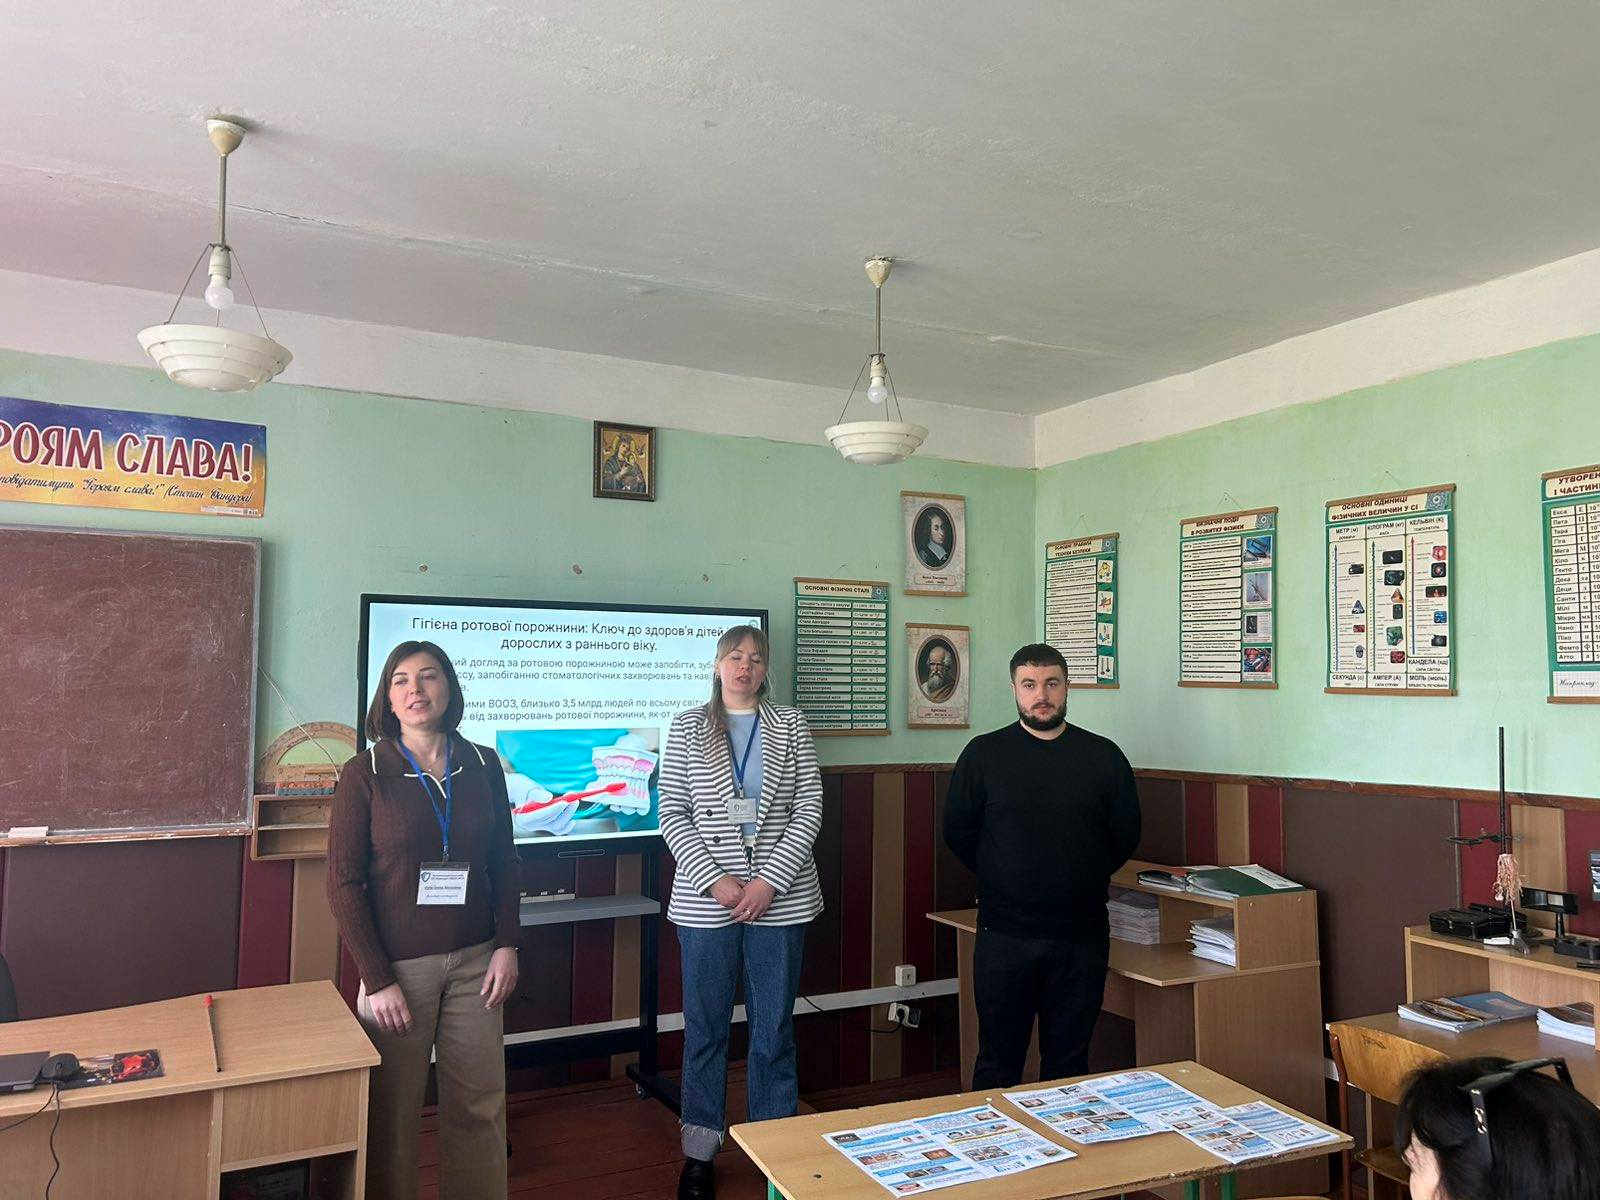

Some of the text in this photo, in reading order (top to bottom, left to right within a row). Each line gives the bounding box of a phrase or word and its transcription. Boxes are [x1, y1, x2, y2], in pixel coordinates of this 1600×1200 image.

[116, 433, 252, 483] СЛАВА!
[1560, 483, 1600, 494] ЧАСТИН
[1342, 496, 1408, 511] ОСНОВНІ ОДИНИЦІ
[1331, 510, 1366, 521] ФІЗИЧНИХ
[1368, 506, 1402, 516] ВЕЛИЧИН
[1195, 526, 1223, 535] РОЗВИТКУ
[1223, 524, 1244, 532] ФІЗИКИ
[412, 617, 457, 630] Гігієна
[461, 620, 512, 632] ротової
[514, 622, 588, 635] порожнини:
[592, 622, 624, 635] Ключ
[627, 625, 642, 636] до
[645, 625, 693, 639] здоров'я
[696, 626, 723, 638] дітей
[501, 638, 657, 653] дорослих з раннього віку.
[469, 659, 505, 668] догляд
[507, 659, 518, 667] за
[521, 659, 563, 669] ротовою
[565, 660, 625, 670] порожниною
[628, 661, 652, 669] може
[654, 660, 697, 671] запобігти,
[477, 670, 540, 680] запобіганню
[542, 671, 621, 681] стоматологічних
[623, 672, 681, 681] захворювань
[682, 672, 692, 680] та
[488, 699, 518, 709] ВООЗ,
[521, 699, 560, 709] близько
[562, 699, 576, 709] 3,5
[578, 700, 602, 709] млрд
[604, 698, 633, 709] людей
[636, 699, 647, 707] по
[649, 699, 681, 709] всьому
[469, 712, 485, 722] від
[487, 713, 553, 722] захворювань
[556, 711, 592, 722] ротової
[594, 711, 647, 721] порожнини,
